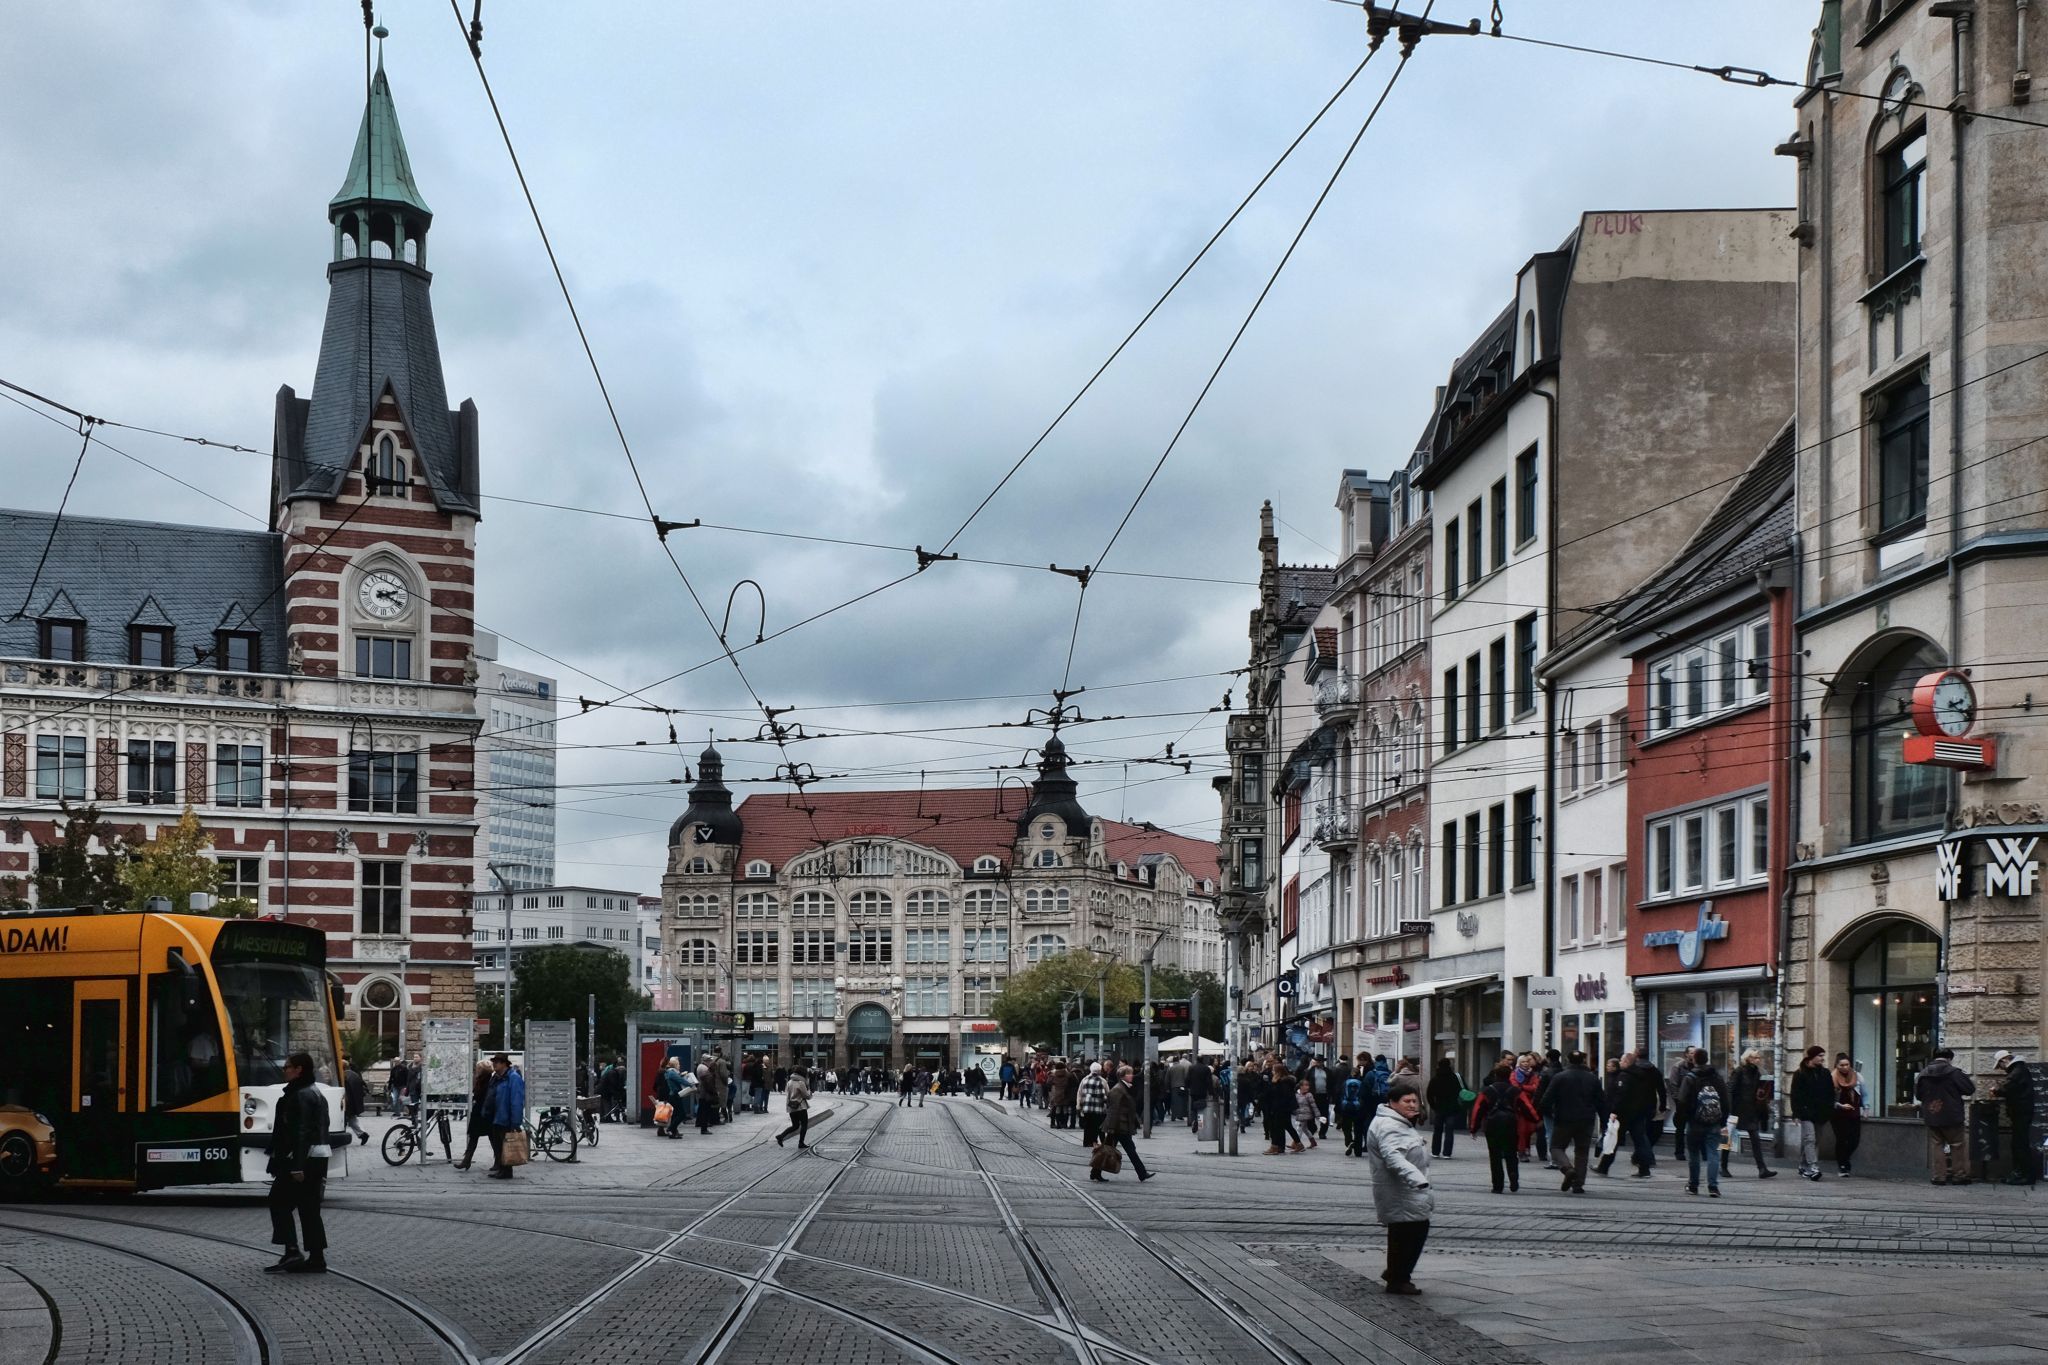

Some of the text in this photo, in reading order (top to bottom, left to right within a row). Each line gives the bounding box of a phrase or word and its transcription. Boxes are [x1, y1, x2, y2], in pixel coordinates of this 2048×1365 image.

[1936, 841, 1962, 900] WMF
[1986, 837, 2039, 897] WMF
[0, 925, 69, 953] DAM!
[204, 1147, 228, 1160] 650
